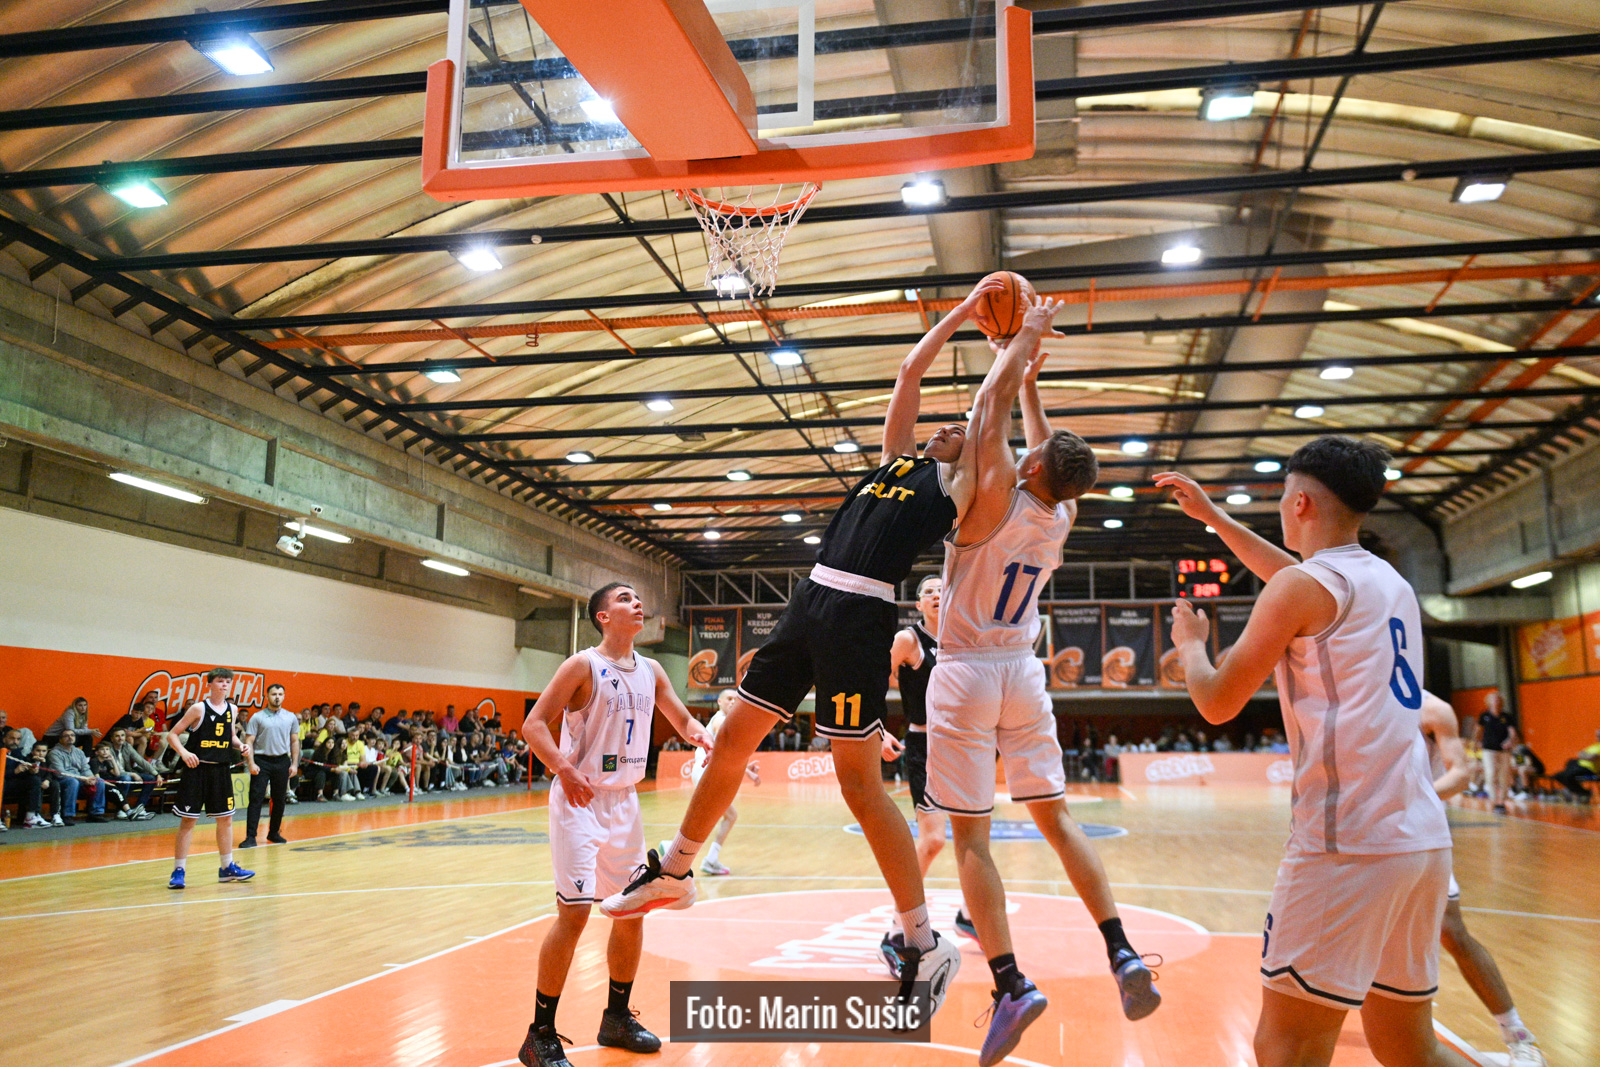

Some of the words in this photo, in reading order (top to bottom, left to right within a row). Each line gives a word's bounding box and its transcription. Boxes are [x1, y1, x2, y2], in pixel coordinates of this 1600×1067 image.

[993, 562, 1043, 625] 17
[1389, 617, 1421, 710] 6
[607, 692, 651, 718] ZADAR
[831, 692, 862, 727] 11
[215, 722, 225, 737] 5
[625, 719, 635, 745] 7
[227, 797, 234, 811] 5
